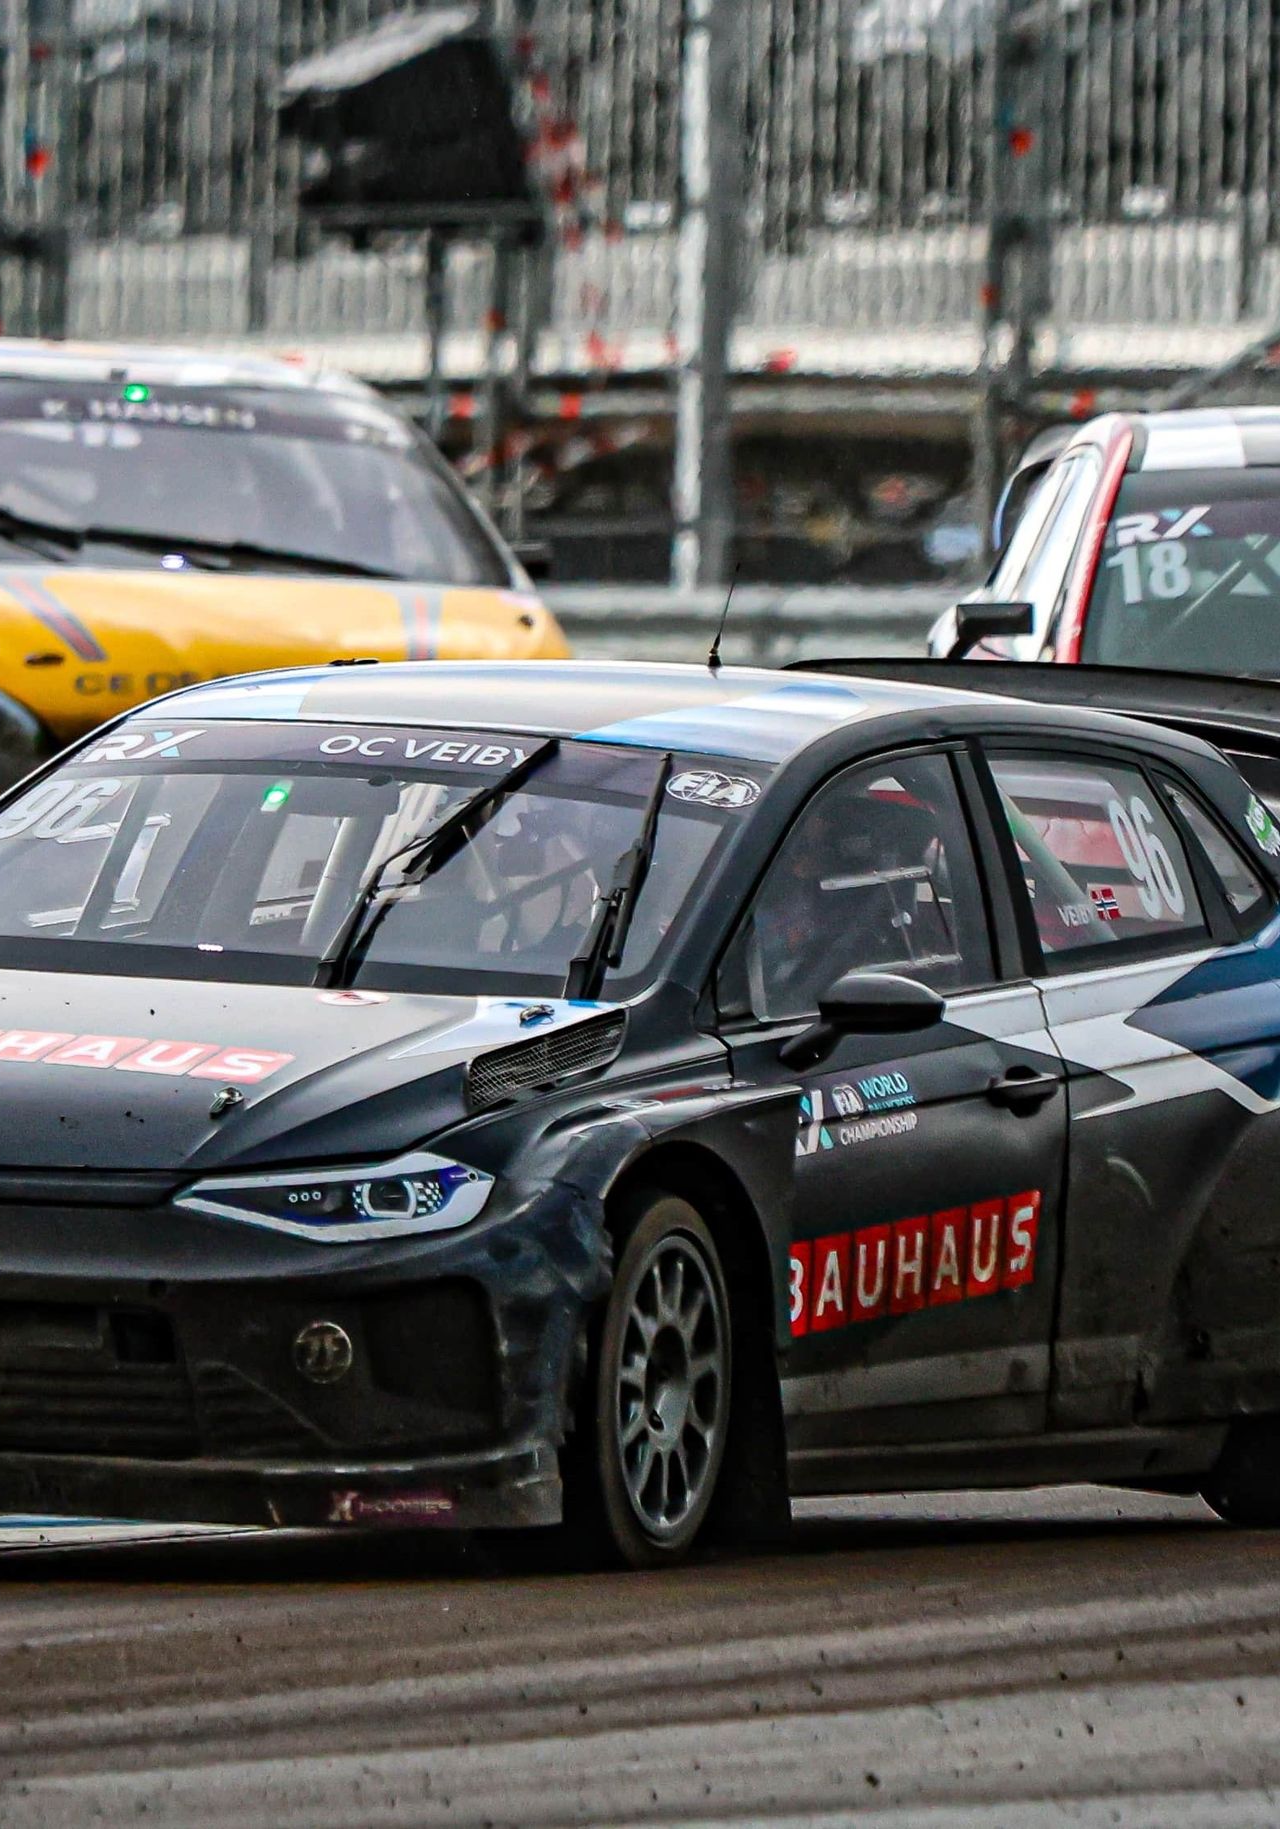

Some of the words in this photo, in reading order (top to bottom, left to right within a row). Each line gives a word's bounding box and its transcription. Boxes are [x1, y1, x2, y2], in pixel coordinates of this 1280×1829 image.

[1106, 541, 1192, 603] 18
[319, 734, 396, 757] OC
[668, 772, 755, 805] FIA
[1108, 795, 1186, 920] 96
[858, 1070, 910, 1099] WORLD
[839, 1111, 918, 1146] CHAMPIONSHIP
